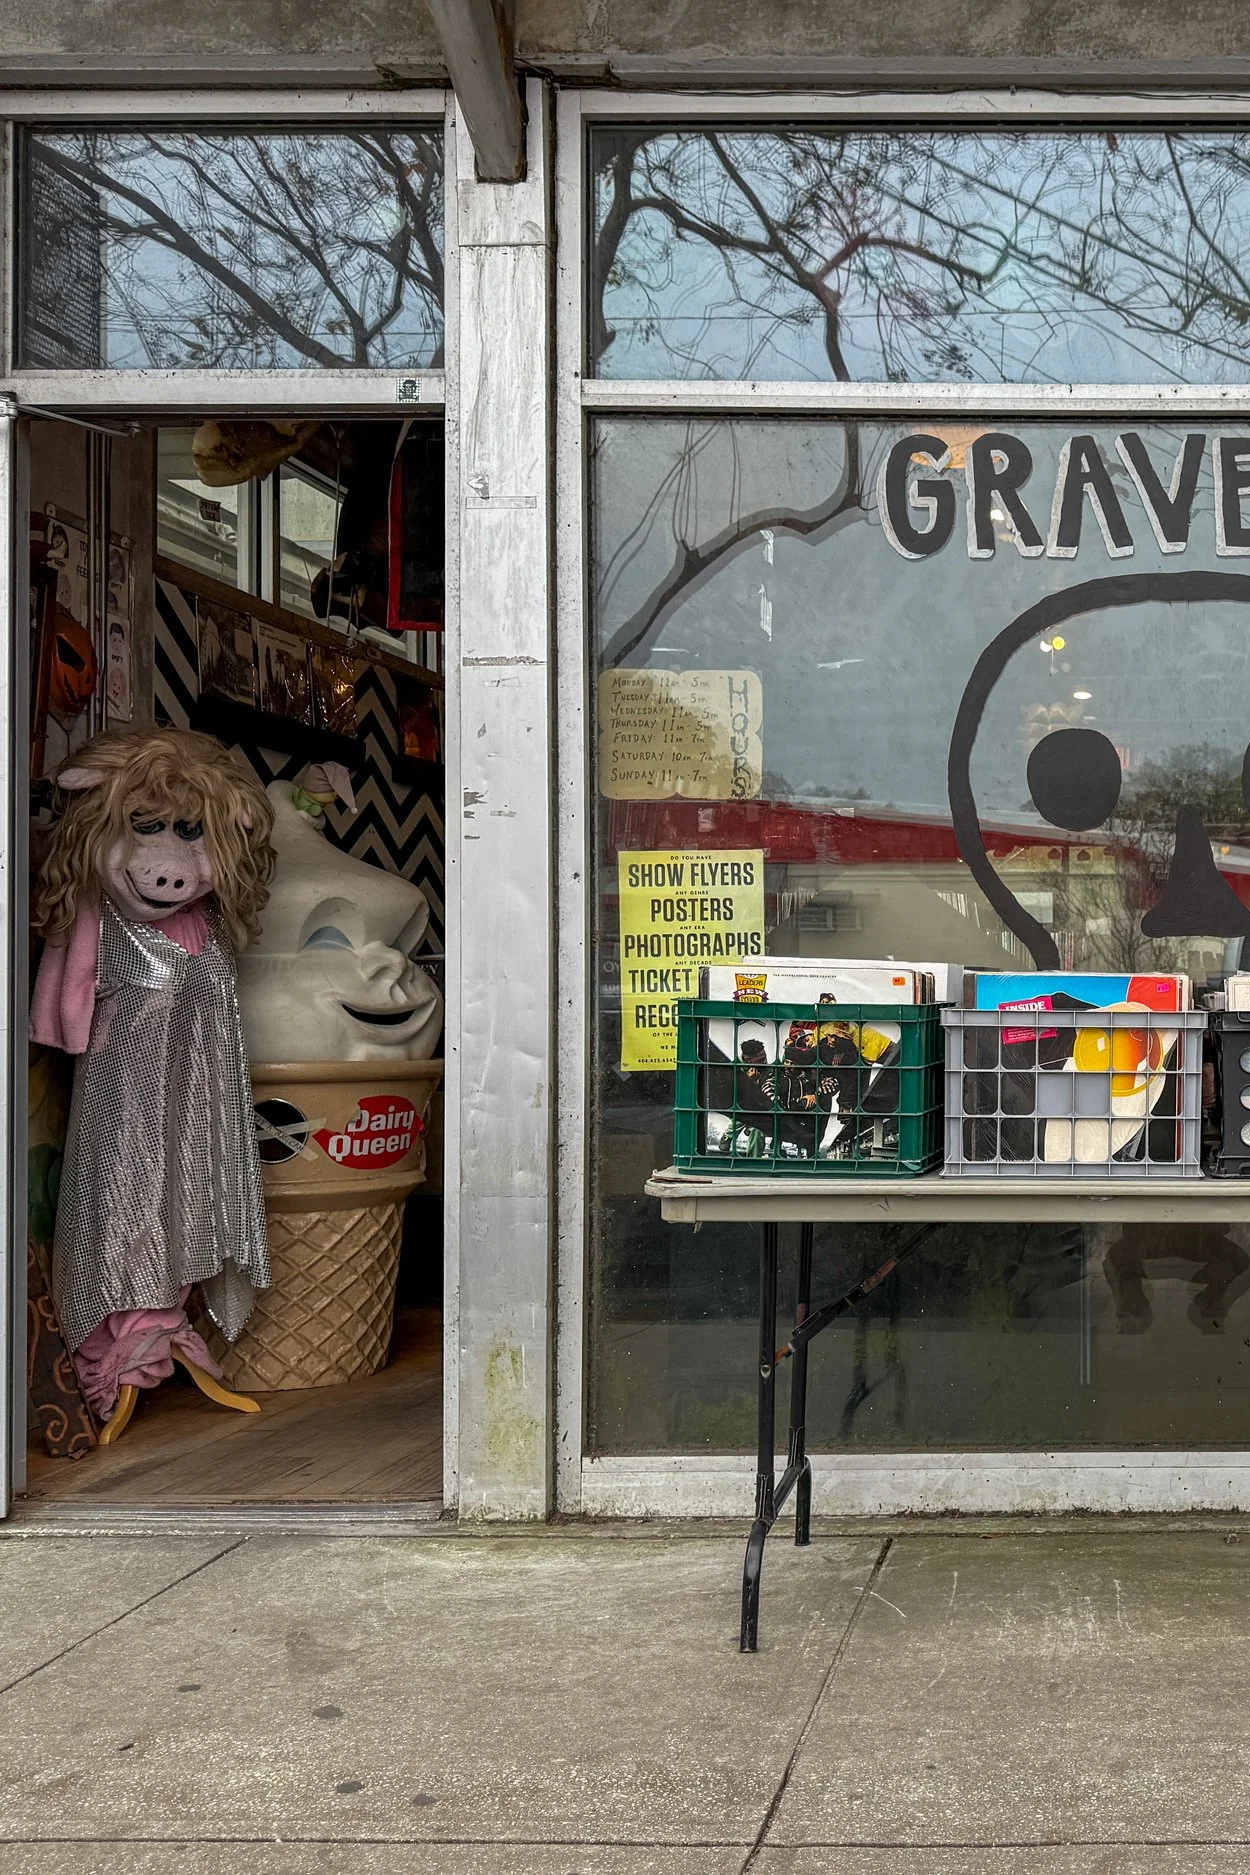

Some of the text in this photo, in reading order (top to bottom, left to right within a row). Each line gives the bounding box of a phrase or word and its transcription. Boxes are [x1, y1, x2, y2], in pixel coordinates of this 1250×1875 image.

[727, 676, 752, 799] HOURS
[628, 861, 755, 888] SHOW FLYERS
[651, 897, 734, 923] POSTERS
[624, 931, 762, 958] PHOTOGRAPHS
[628, 968, 693, 993] TICKET
[737, 989, 767, 997] NEW
[738, 979, 764, 987] LEADERS
[635, 1003, 679, 1029] RECO
[1004, 1000, 1047, 1012] INSIDE
[347, 1105, 415, 1132] Dairy
[328, 1132, 411, 1162] Queen
